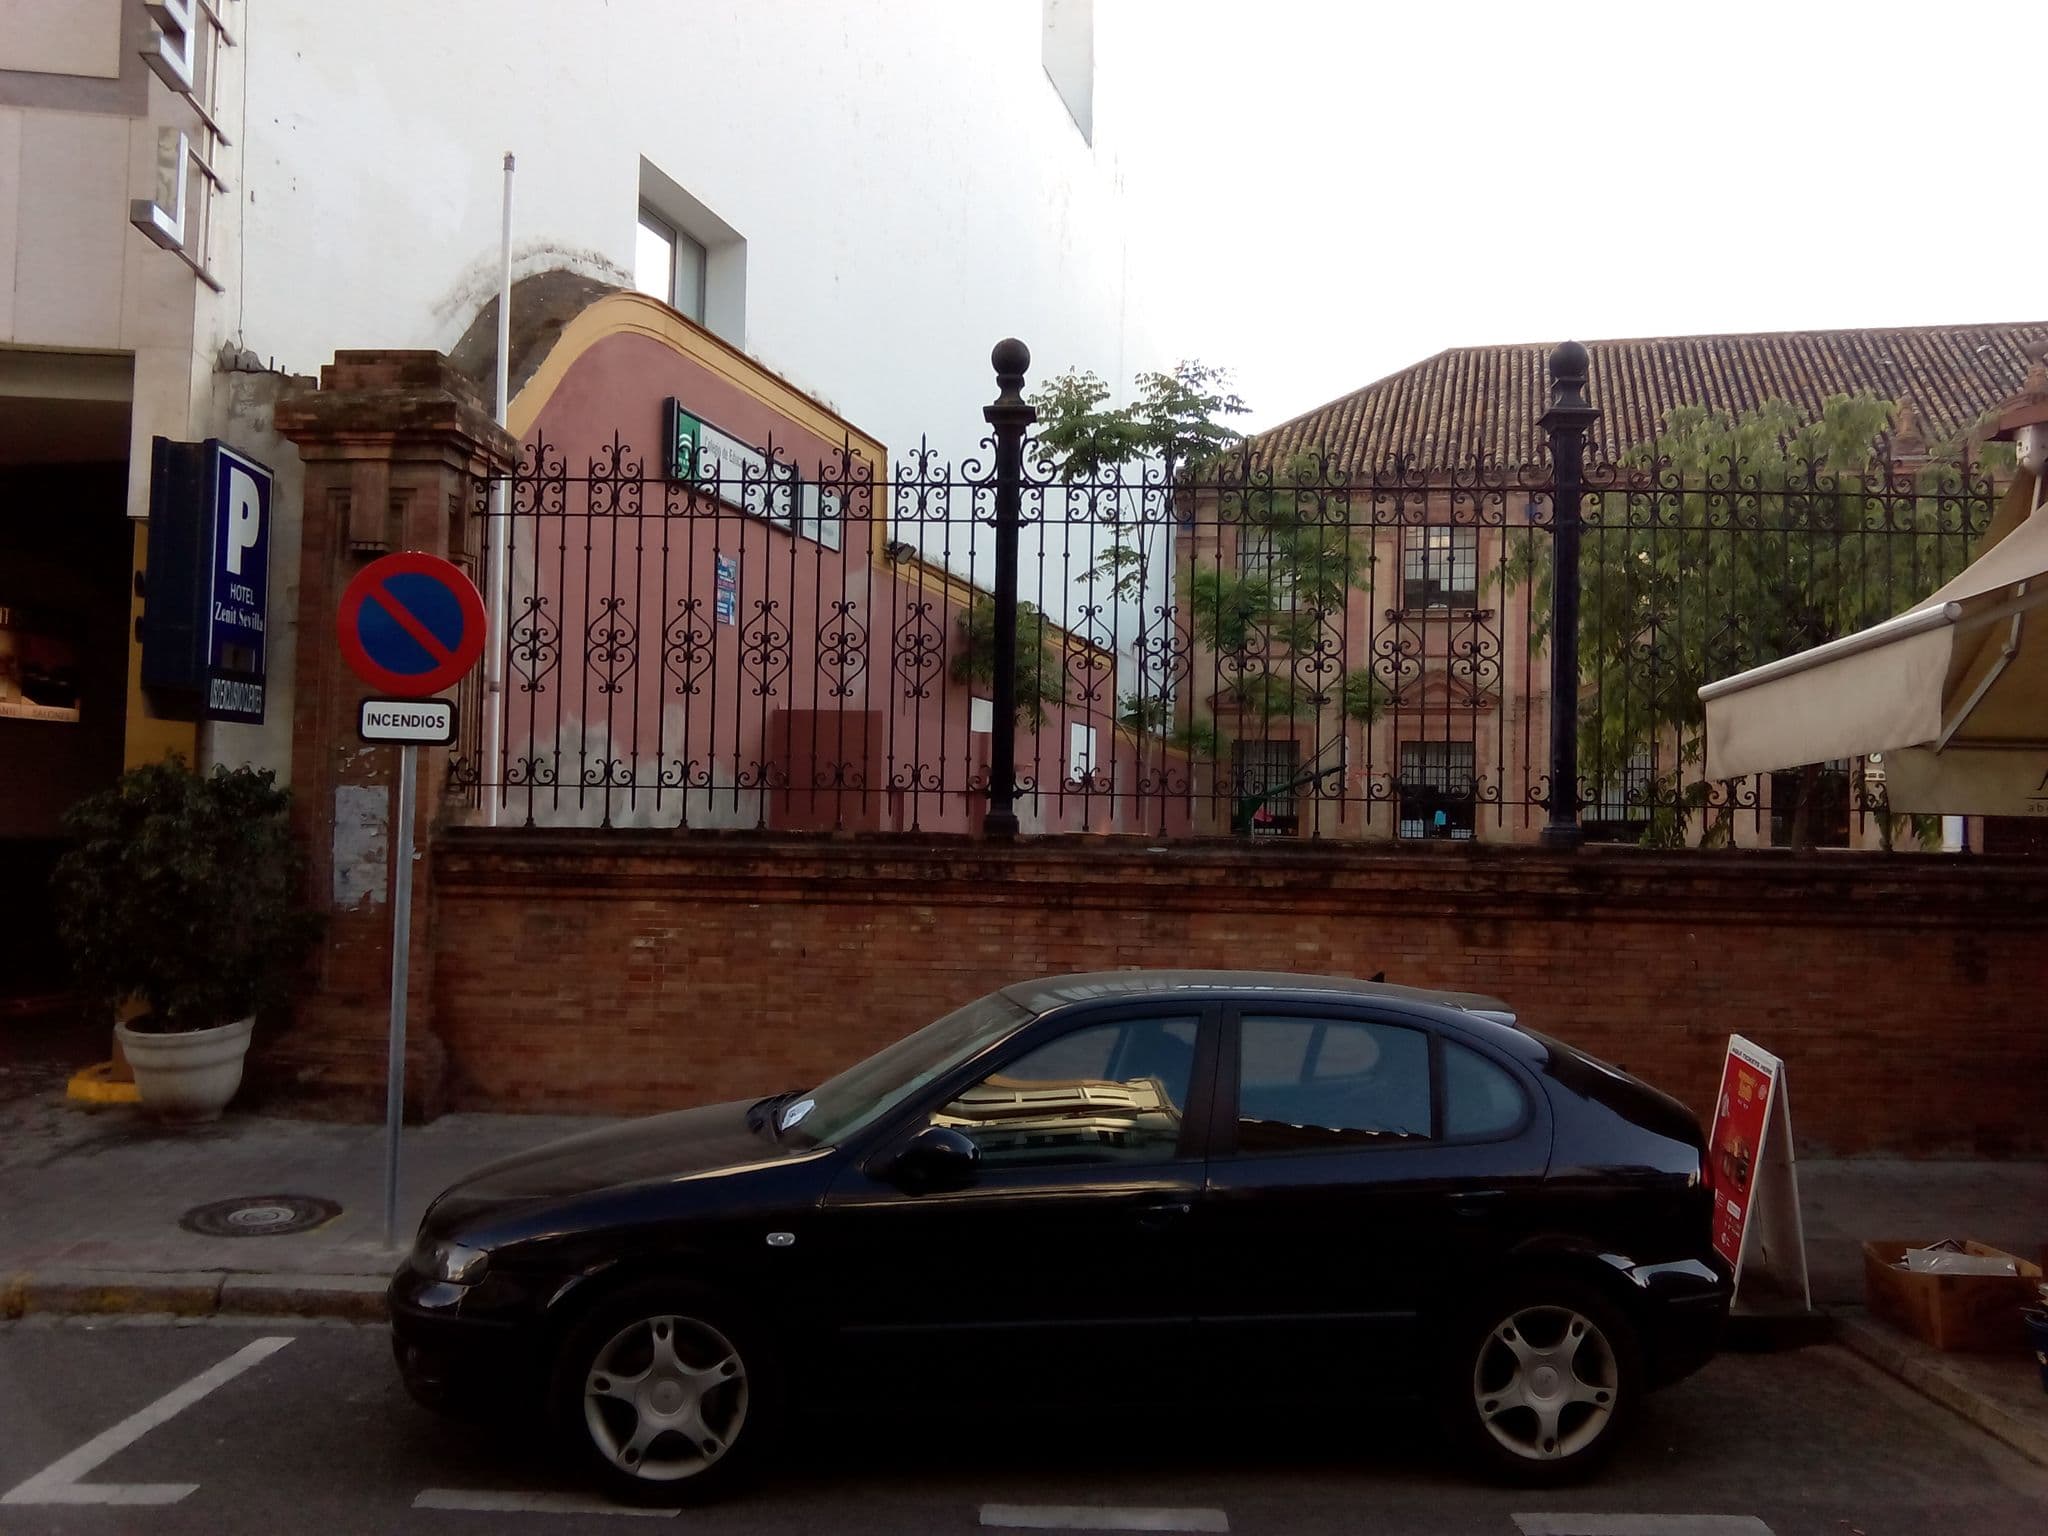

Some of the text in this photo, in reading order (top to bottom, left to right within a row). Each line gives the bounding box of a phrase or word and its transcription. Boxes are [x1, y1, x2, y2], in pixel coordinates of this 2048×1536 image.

[226, 466, 260, 576] P
[230, 583, 255, 605] HOTEL
[214, 601, 264, 632] Zenit Sevilla
[367, 712, 445, 729] INCENDIOS
[1742, 1053, 1761, 1068] TICKETS
